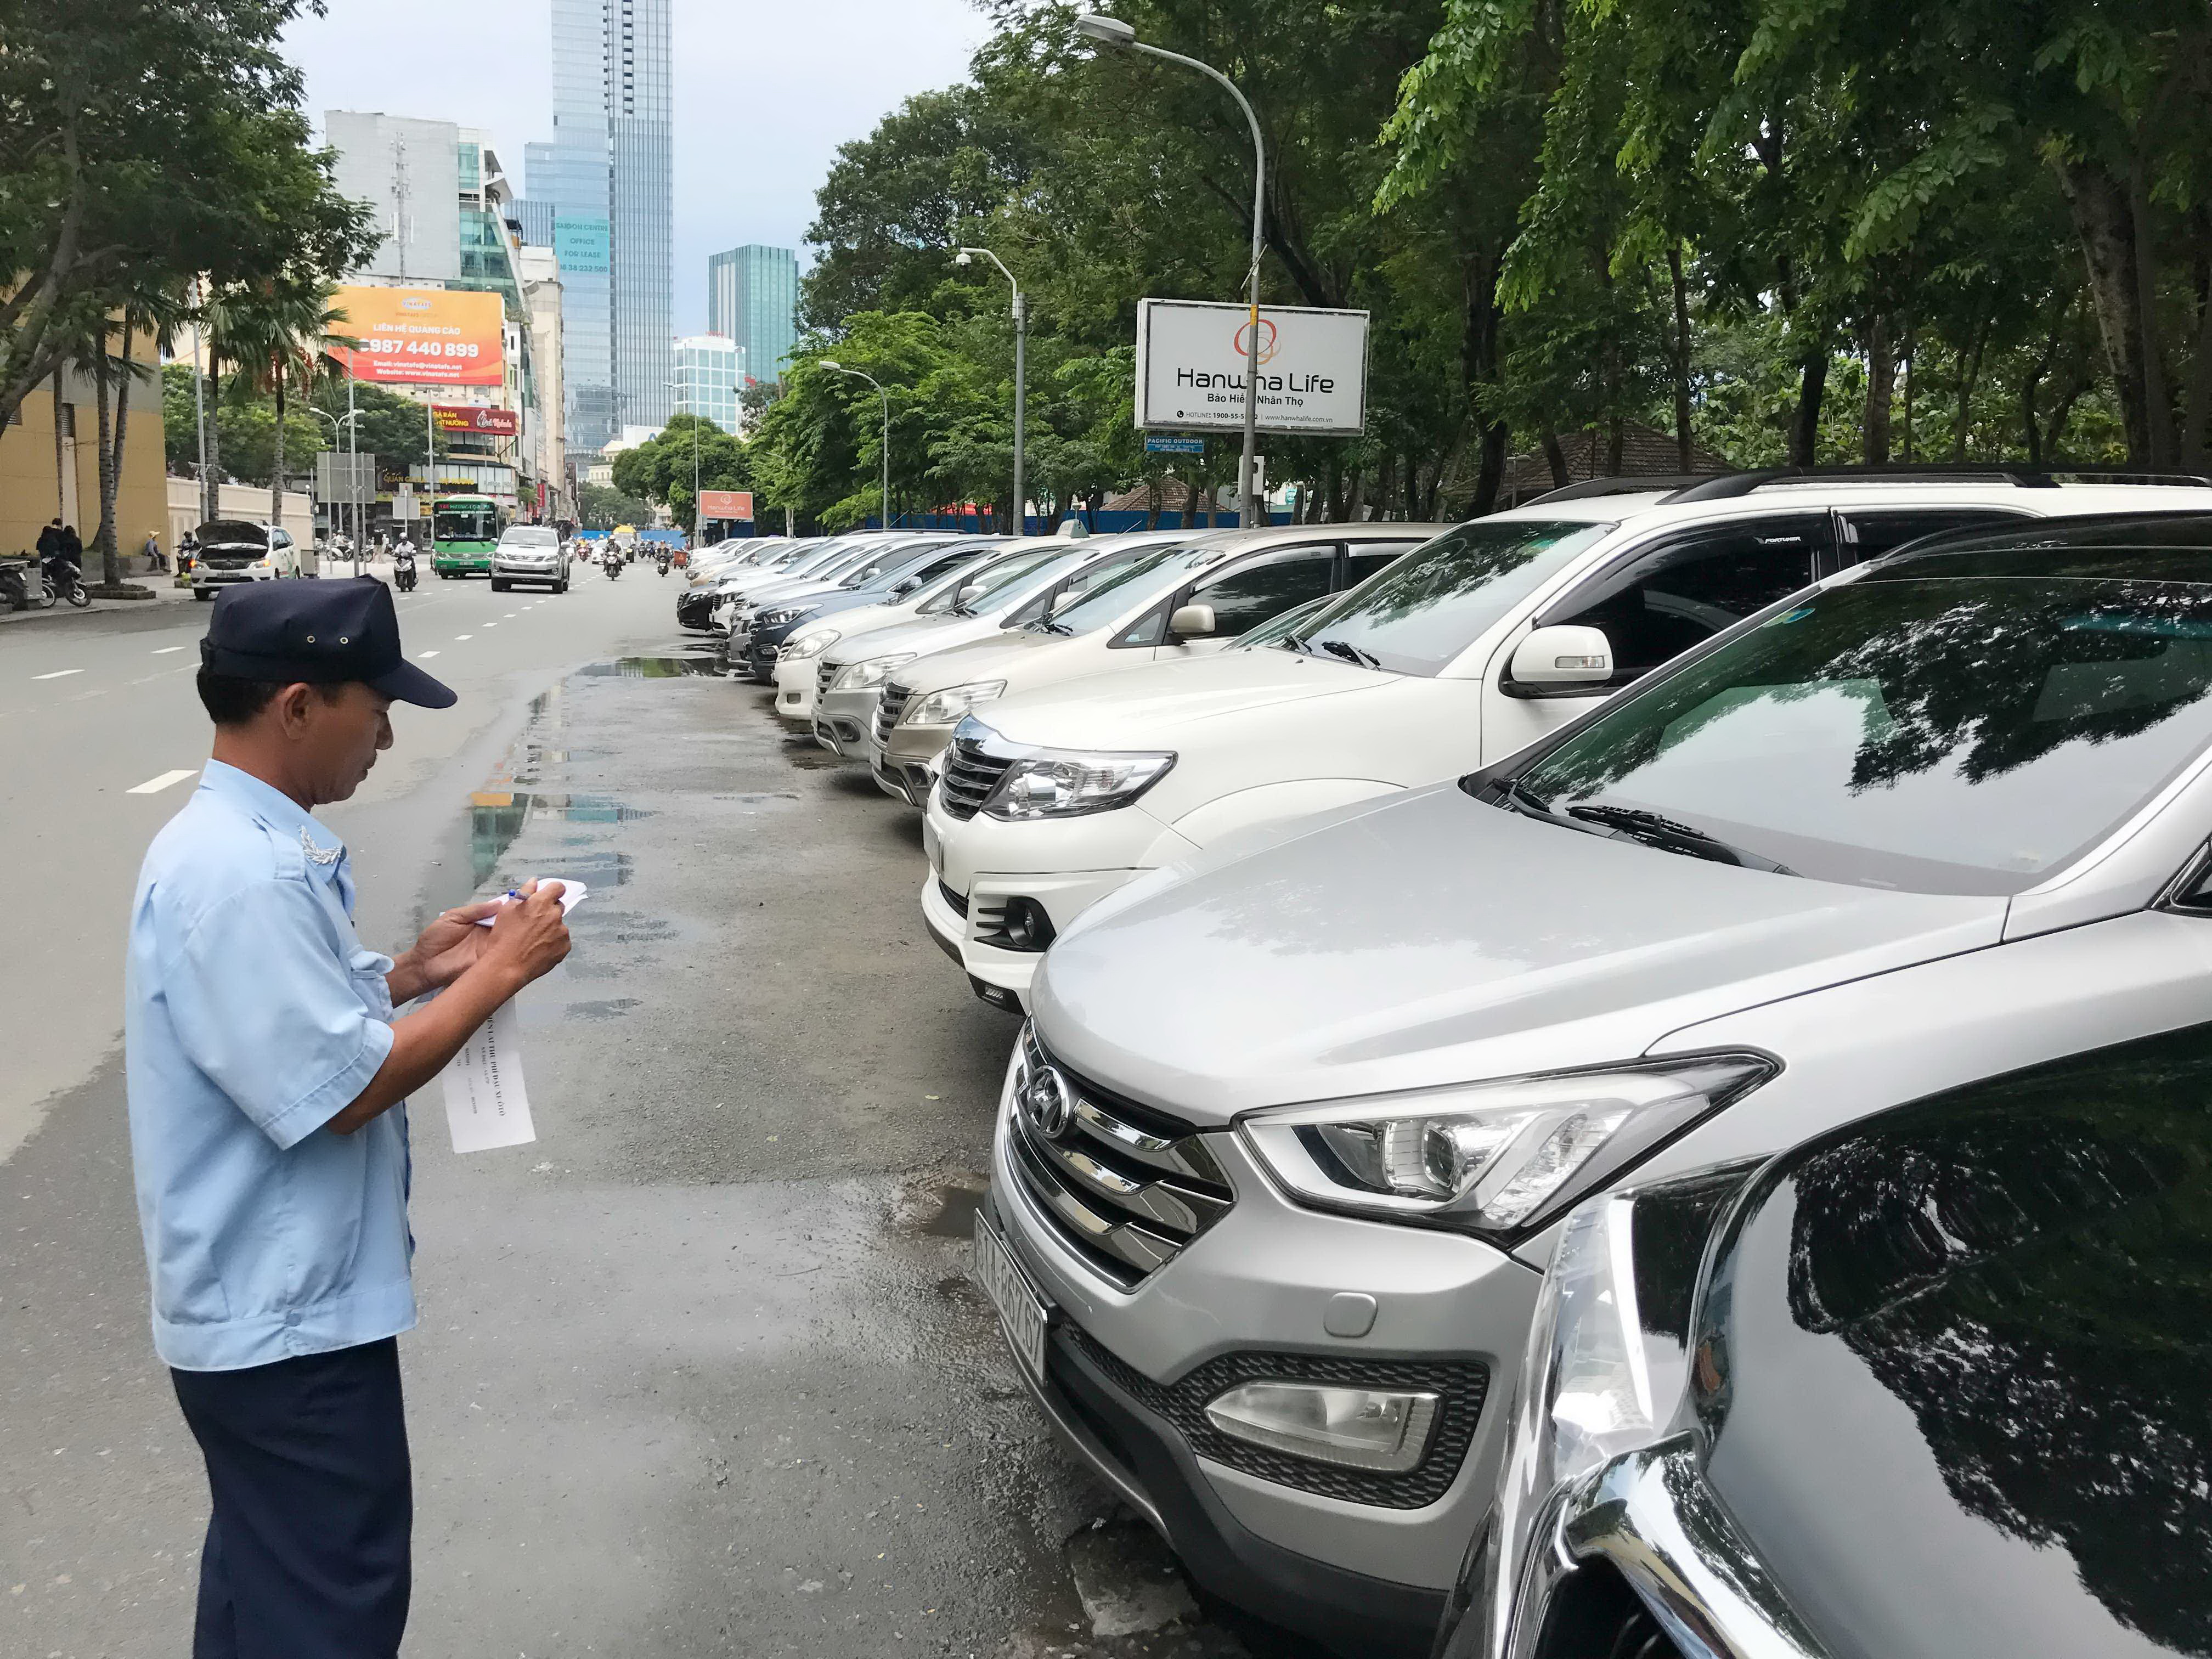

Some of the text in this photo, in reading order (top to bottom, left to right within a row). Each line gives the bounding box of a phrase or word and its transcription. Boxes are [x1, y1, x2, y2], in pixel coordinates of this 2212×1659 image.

[373, 323, 394, 331] LIÊN
[409, 324, 441, 334] QUẢNG
[442, 325, 461, 335] CÁO
[406, 341, 442, 356] 440
[444, 343, 479, 358] 899
[1289, 373, 1335, 393] Life
[1207, 392, 1304, 408] Bảo Hiể Nhân Thọ
[1265, 414, 1333, 423] www.hanwhalife.com.vn
[1765, 536, 1802, 544] FORTUNER
